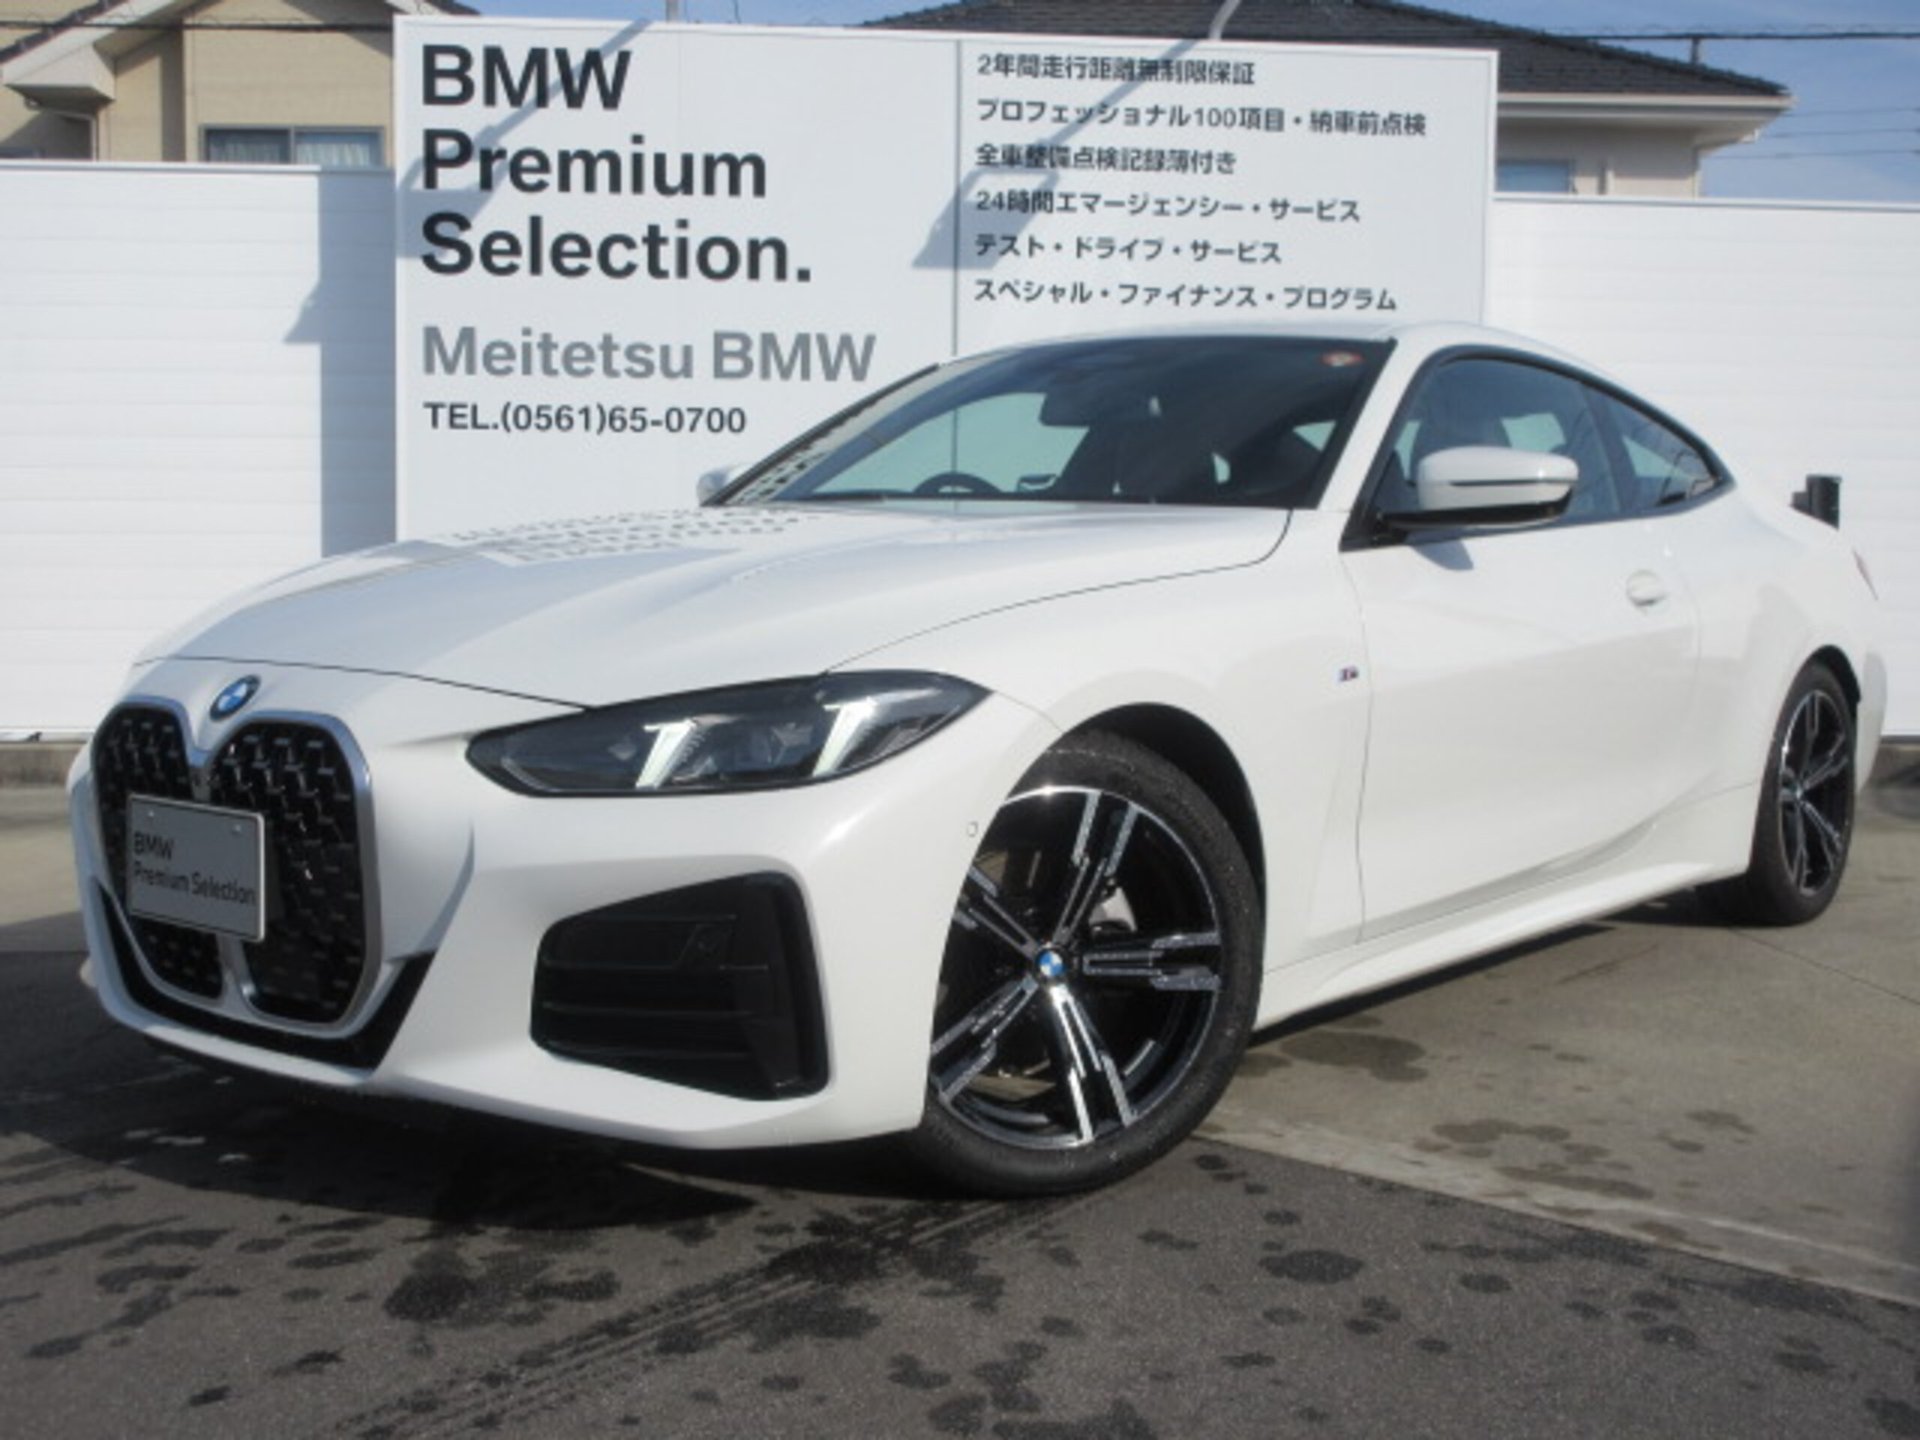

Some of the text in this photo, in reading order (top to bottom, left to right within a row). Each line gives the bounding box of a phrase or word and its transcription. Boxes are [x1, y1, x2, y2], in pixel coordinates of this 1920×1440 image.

[422, 45, 632, 110] BMW
[977, 54, 1256, 85] 2年間走行距離無制限保証
[977, 99, 1427, 136] プロフェッショナル100項目・納車前点検
[422, 128, 767, 197] Premium
[975, 190, 1361, 222] 24時間エマージェンシー・サービス
[421, 212, 812, 281] Selection.
[975, 235, 1283, 264] テスト・ドライブ・サービス
[973, 279, 1398, 312] スペシャル・ファイナンス・プログラム
[423, 326, 876, 381] Meitetsu BMW
[423, 402, 746, 435] TEL.(0561)65-0700
[134, 833, 173, 859] BMW
[134, 861, 256, 906] Premium Selection
